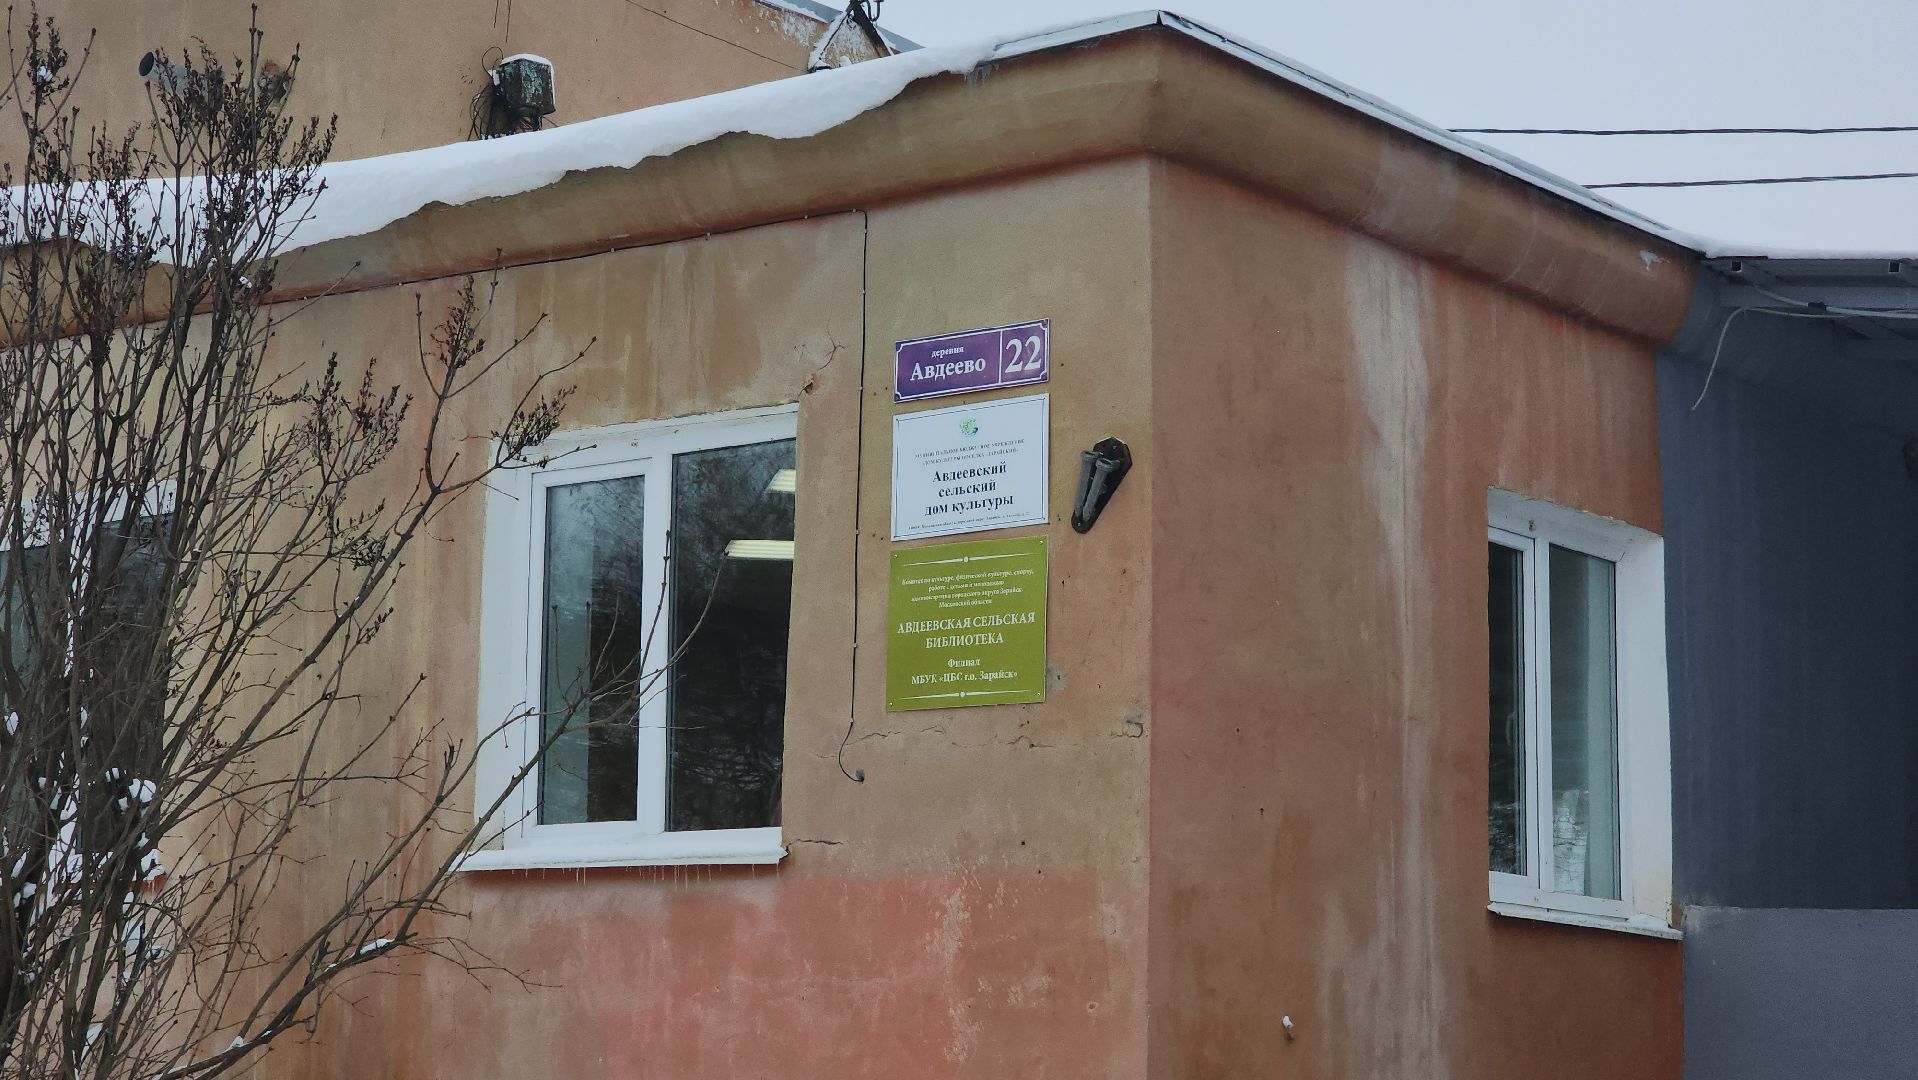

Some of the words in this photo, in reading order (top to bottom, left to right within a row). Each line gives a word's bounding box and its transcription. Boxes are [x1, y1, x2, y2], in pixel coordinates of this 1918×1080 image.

[932, 346, 964, 358] деревня
[1005, 336, 1042, 373] 22
[910, 358, 986, 381] Авдеево
[932, 461, 1006, 482] Авдеевский
[938, 479, 996, 498] сельский
[924, 502, 948, 516] дом
[952, 496, 1014, 514] культуры
[897, 618, 970, 634] АВДЕЕВСКАЯ
[972, 612, 1036, 628] СЕЛЬСКАЯ
[926, 632, 1004, 648] БИБЛИОТЕКА
[948, 658, 980, 668] Филиал
[912, 674, 937, 684] МБУК
[939, 672, 962, 684] «ЦБС
[980, 670, 1018, 682] Зарайск»
